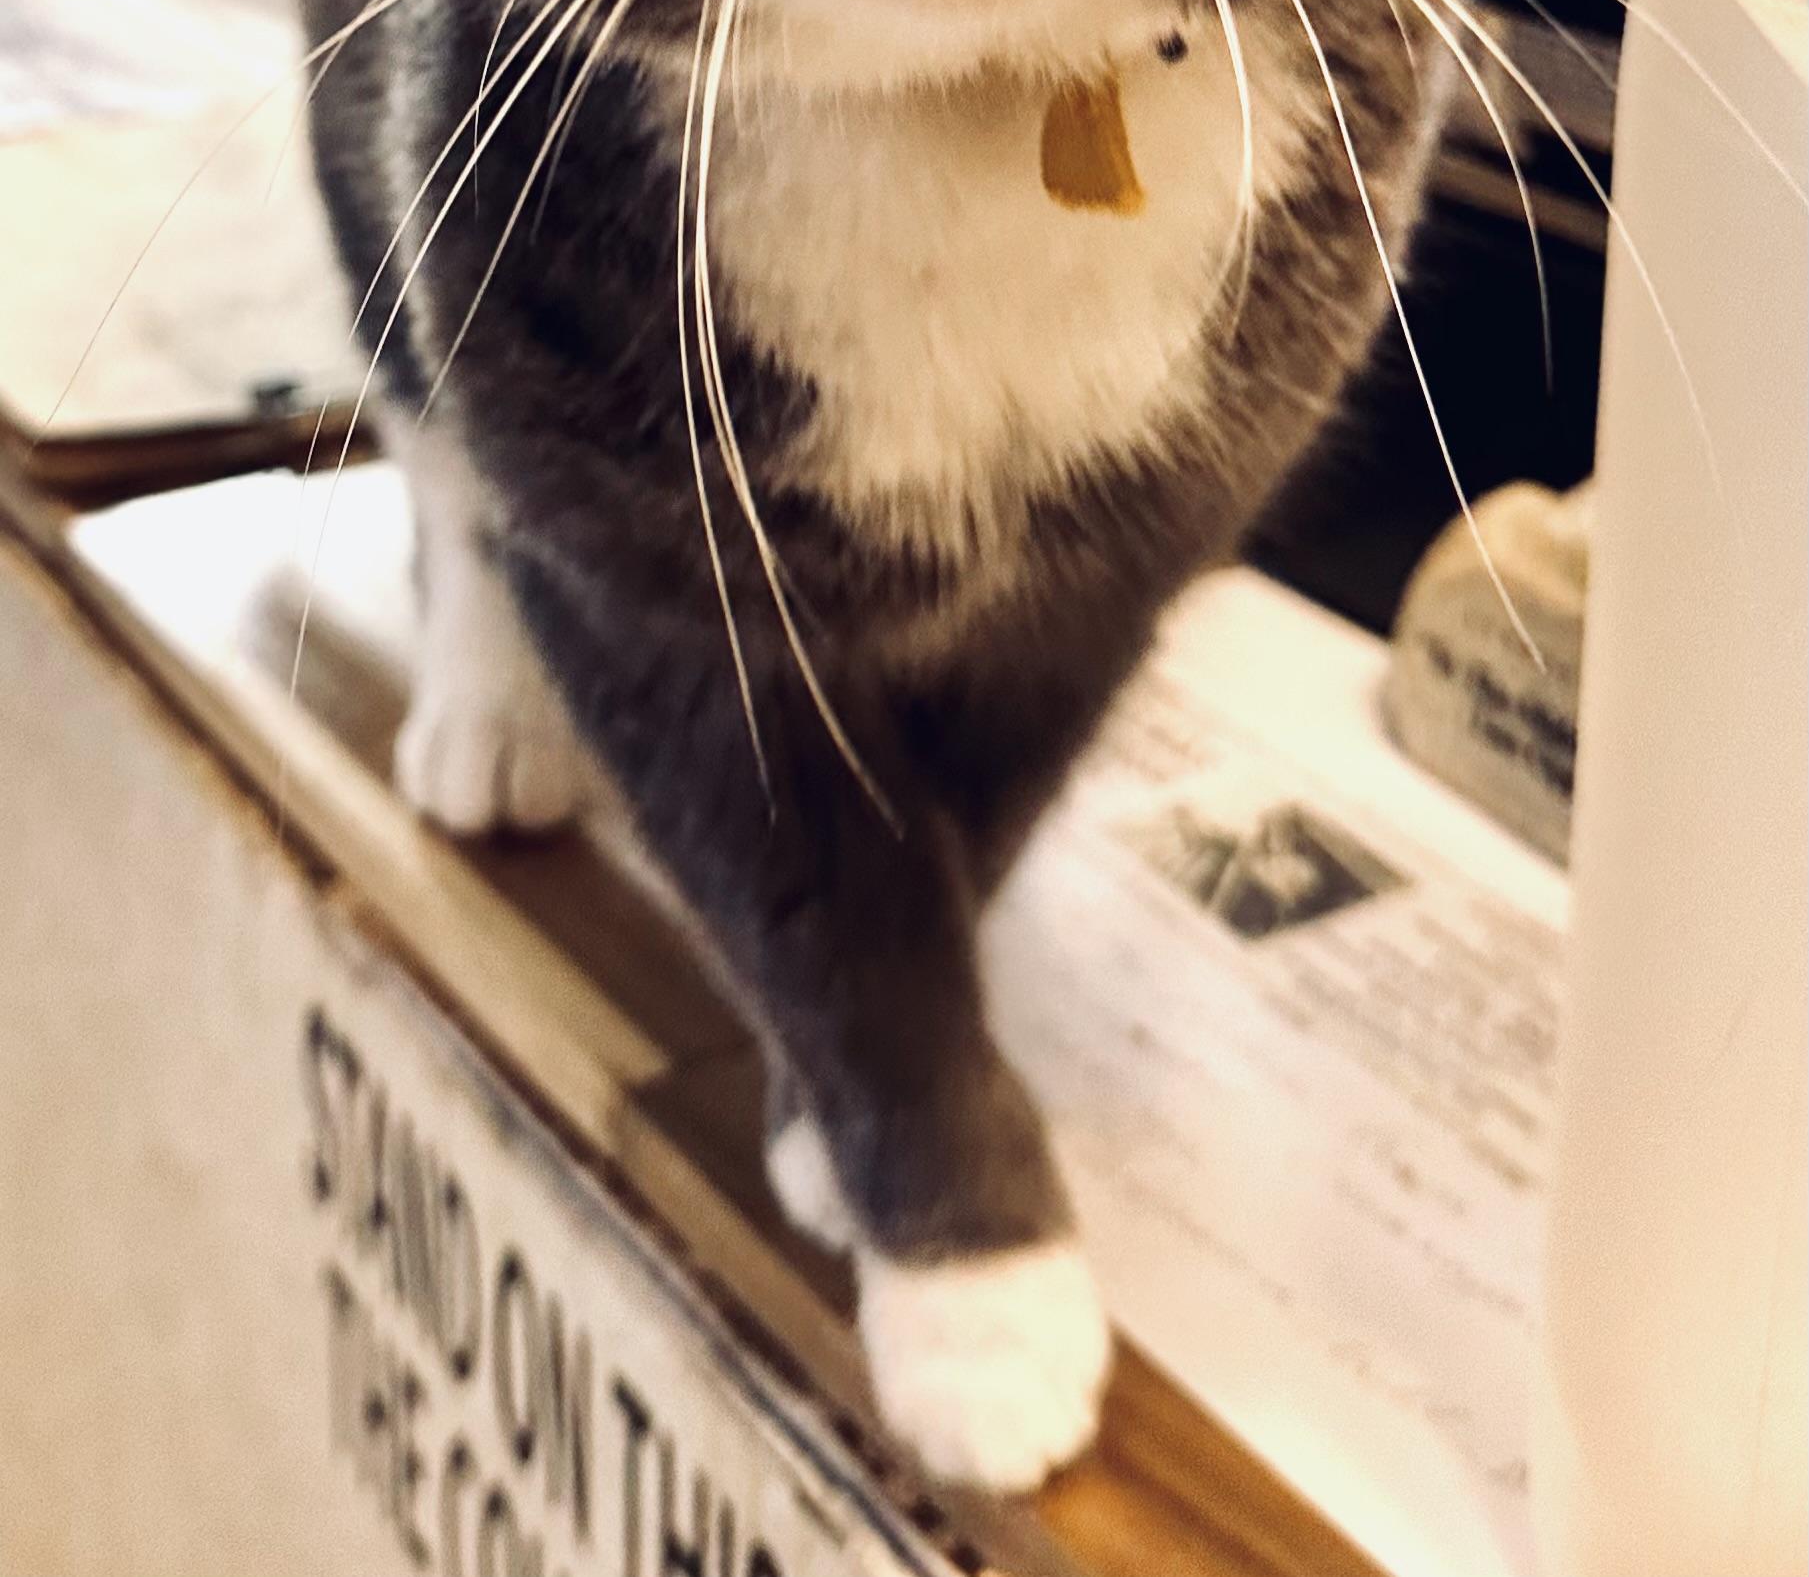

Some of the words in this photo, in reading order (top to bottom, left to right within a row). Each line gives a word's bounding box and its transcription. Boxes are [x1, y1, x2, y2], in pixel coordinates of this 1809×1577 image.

[300, 1005, 482, 1379] STAND
[492, 1249, 594, 1545] ON
[322, 1261, 430, 1570] THE
